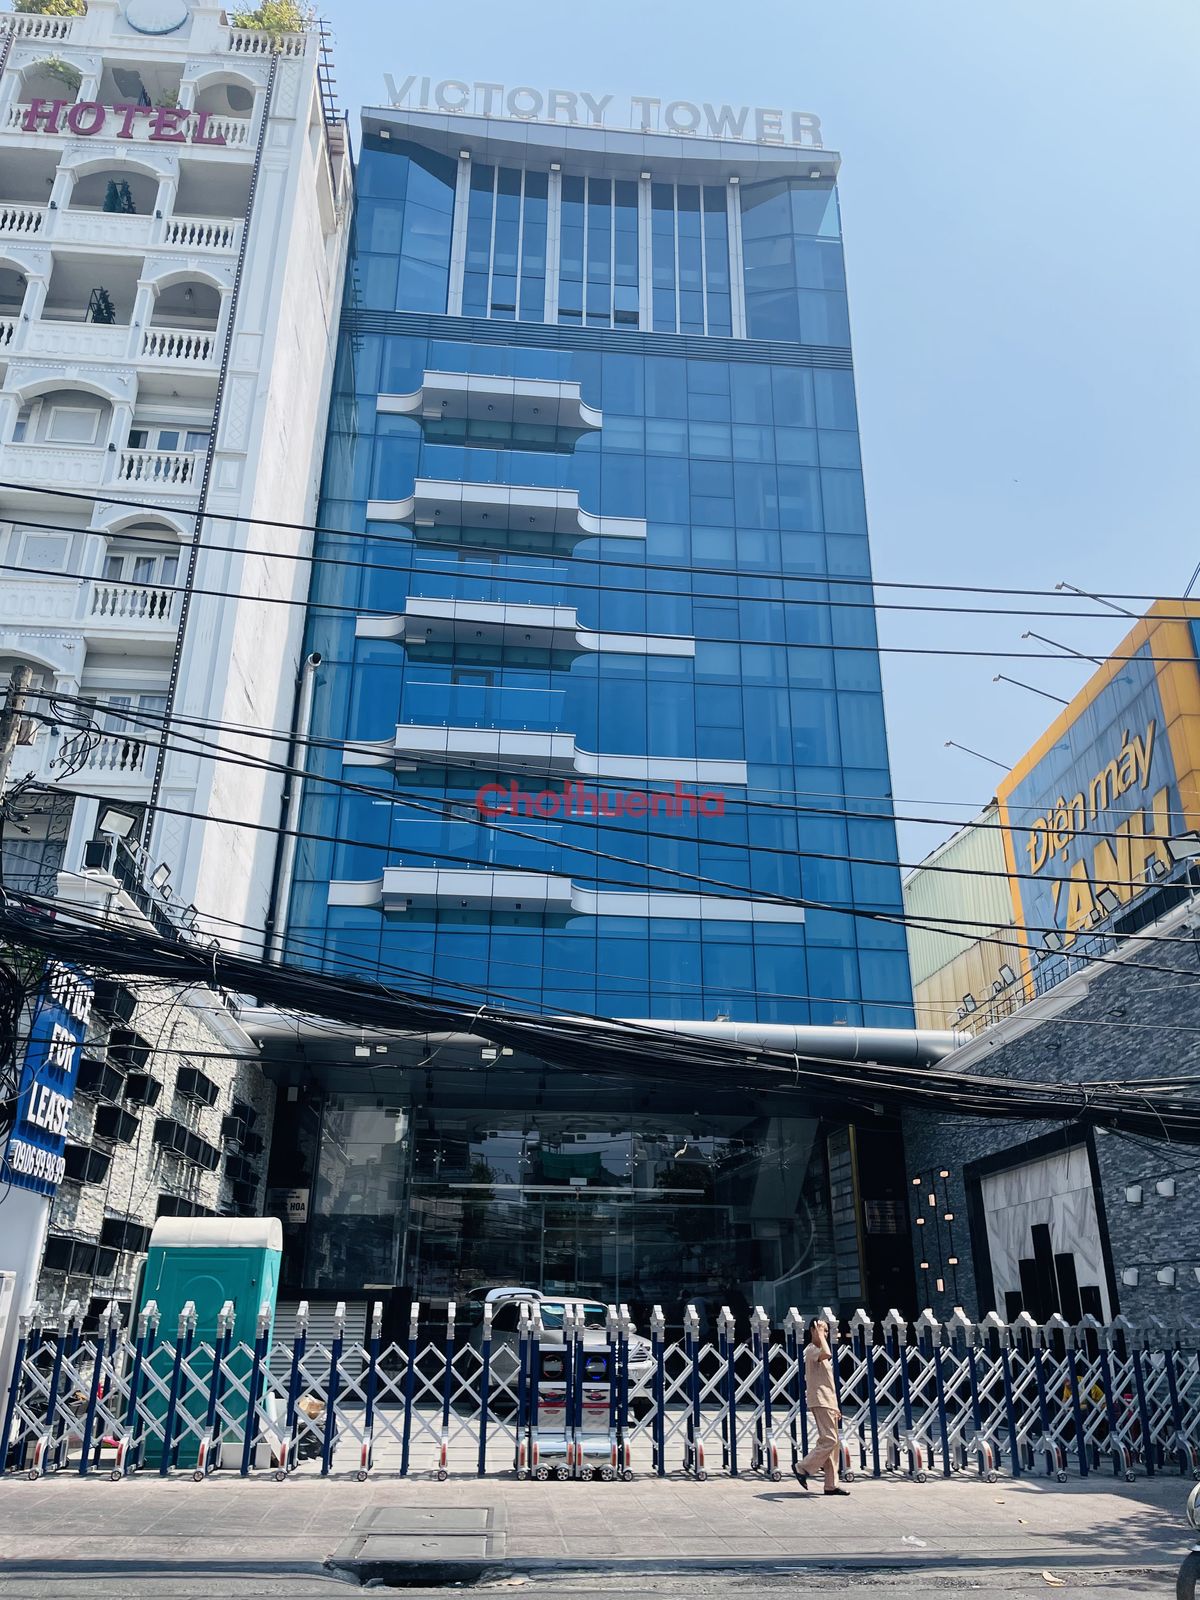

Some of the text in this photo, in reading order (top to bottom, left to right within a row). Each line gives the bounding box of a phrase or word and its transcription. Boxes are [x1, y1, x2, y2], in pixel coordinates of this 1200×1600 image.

[22, 98, 226, 145] HOTEL
[383, 72, 824, 149] VICTORY TOWER
[1088, 719, 1157, 822] máy
[48, 1022, 77, 1072] FOR
[27, 1081, 74, 1138] LEASE
